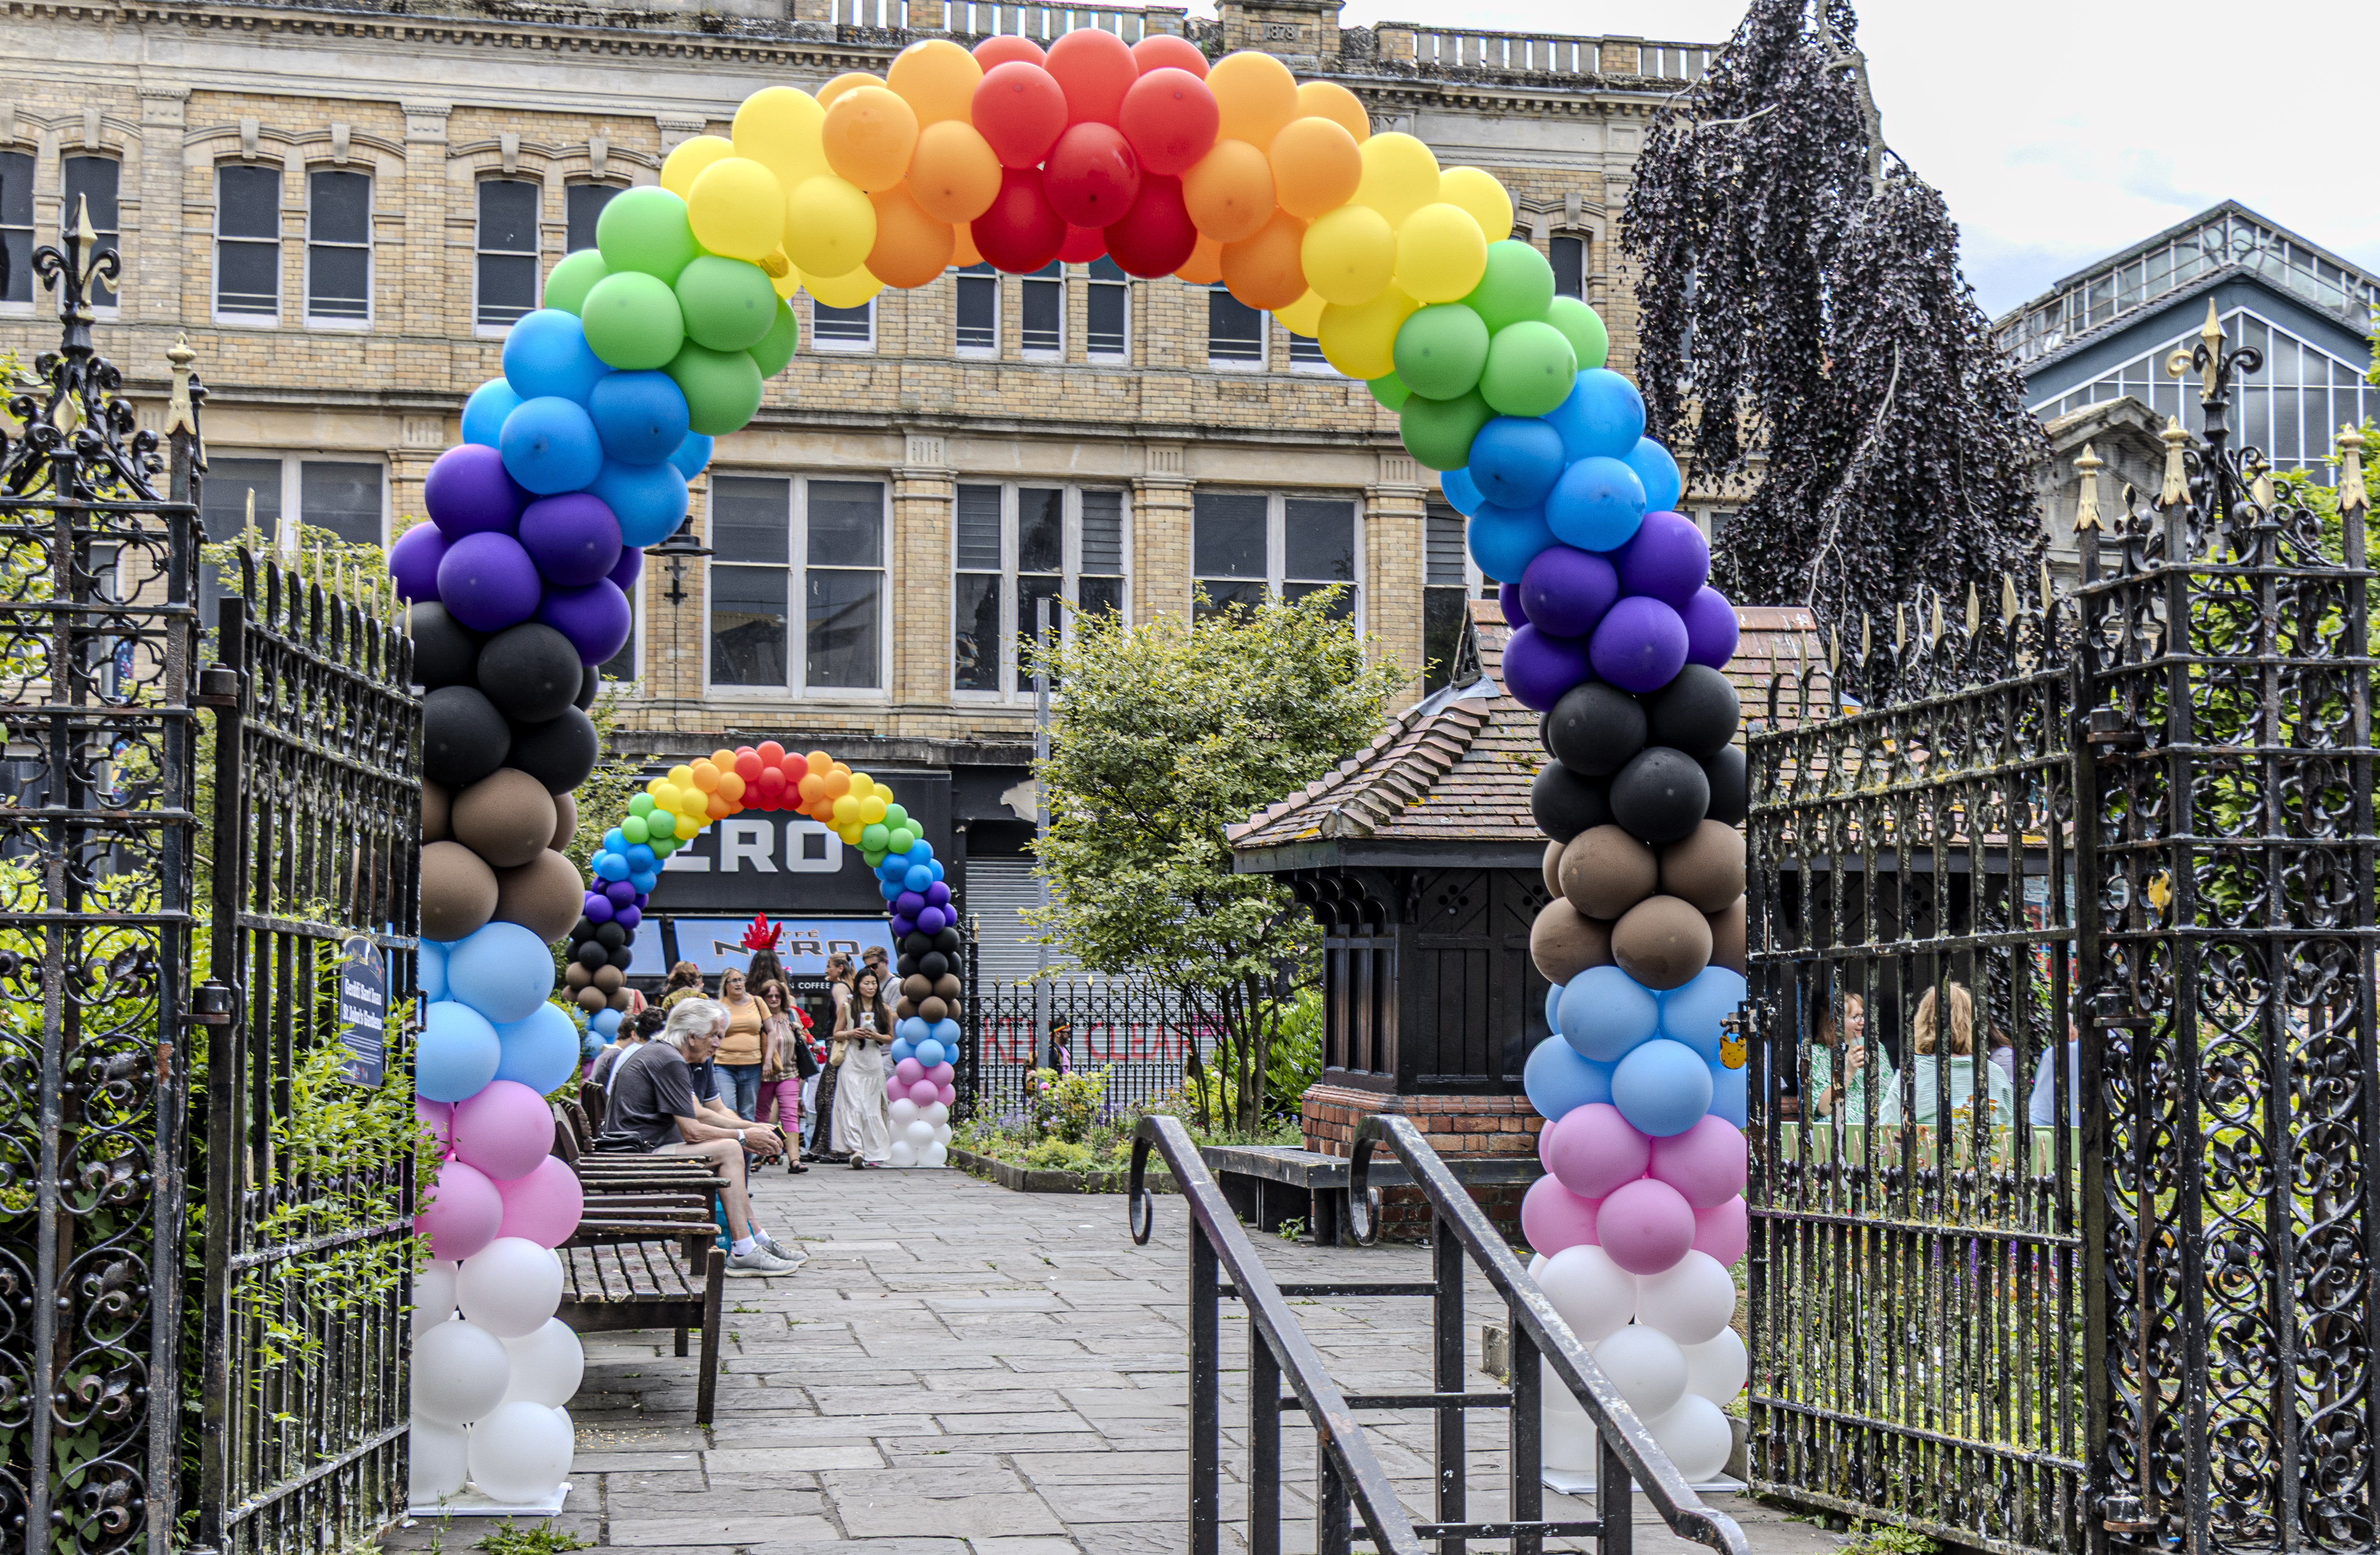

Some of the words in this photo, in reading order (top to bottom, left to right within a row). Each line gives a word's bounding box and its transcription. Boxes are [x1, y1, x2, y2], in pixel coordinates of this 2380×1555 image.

[1266, 24, 1295, 40] 1878
[662, 819, 843, 872] ERO
[342, 1002, 349, 1021] St
[363, 1009, 382, 1031] Gardens
